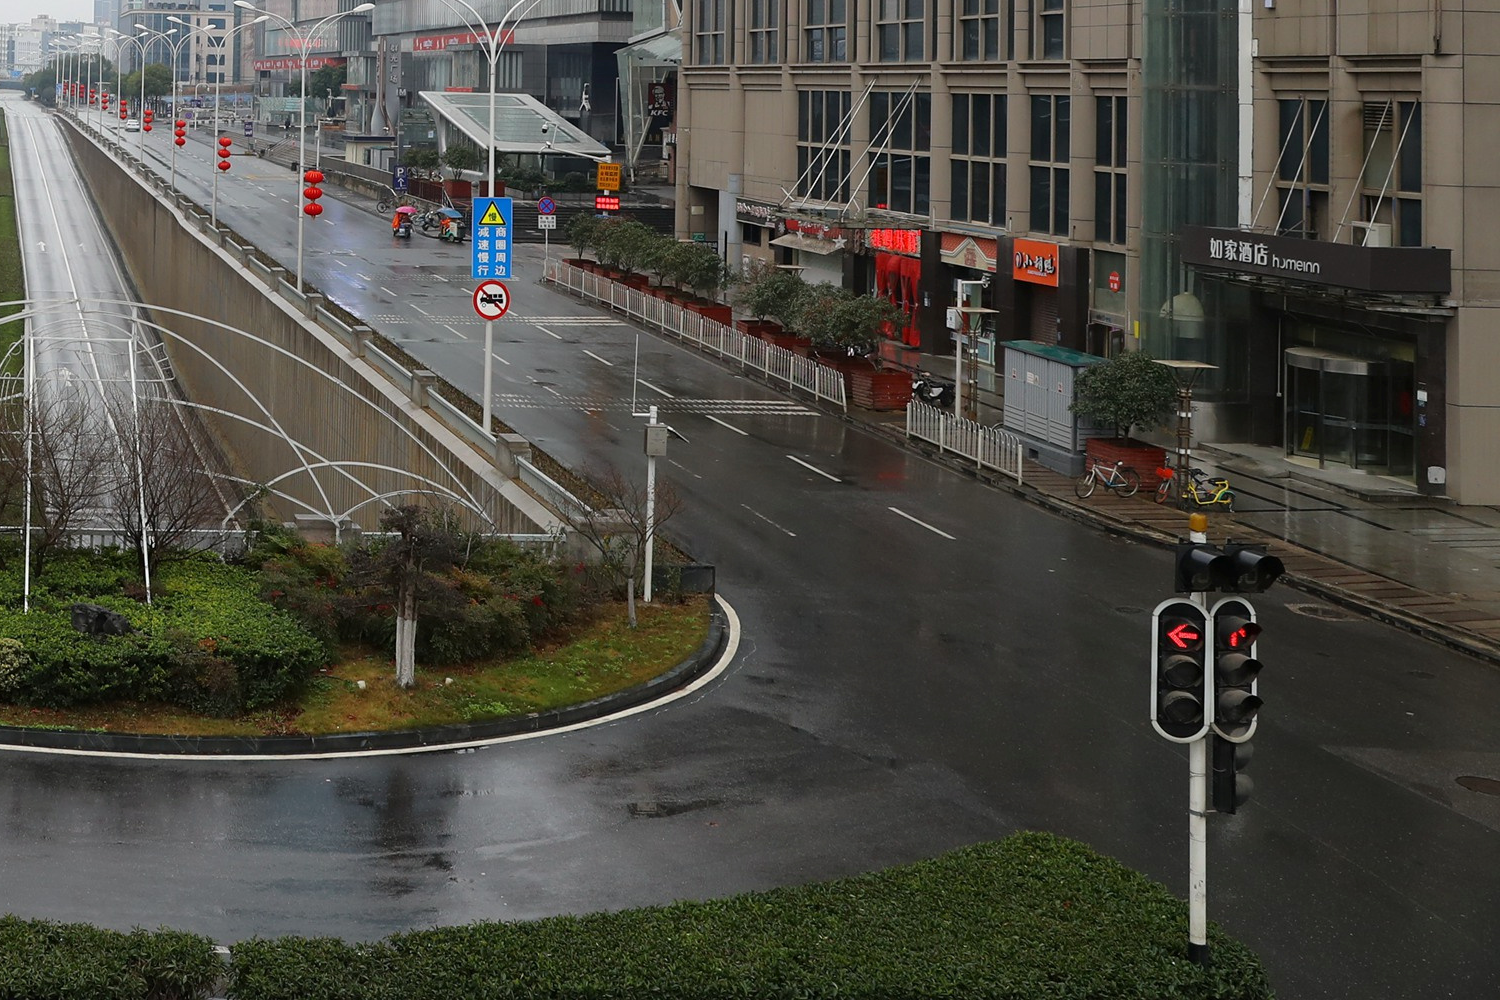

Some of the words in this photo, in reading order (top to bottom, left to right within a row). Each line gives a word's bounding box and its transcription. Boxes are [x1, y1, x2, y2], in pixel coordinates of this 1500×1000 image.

[650, 109, 669, 117] KFC
[477, 226, 490, 276] 减速慢行
[494, 227, 507, 276] 商圈周边
[1209, 237, 1269, 266] 如家酒店
